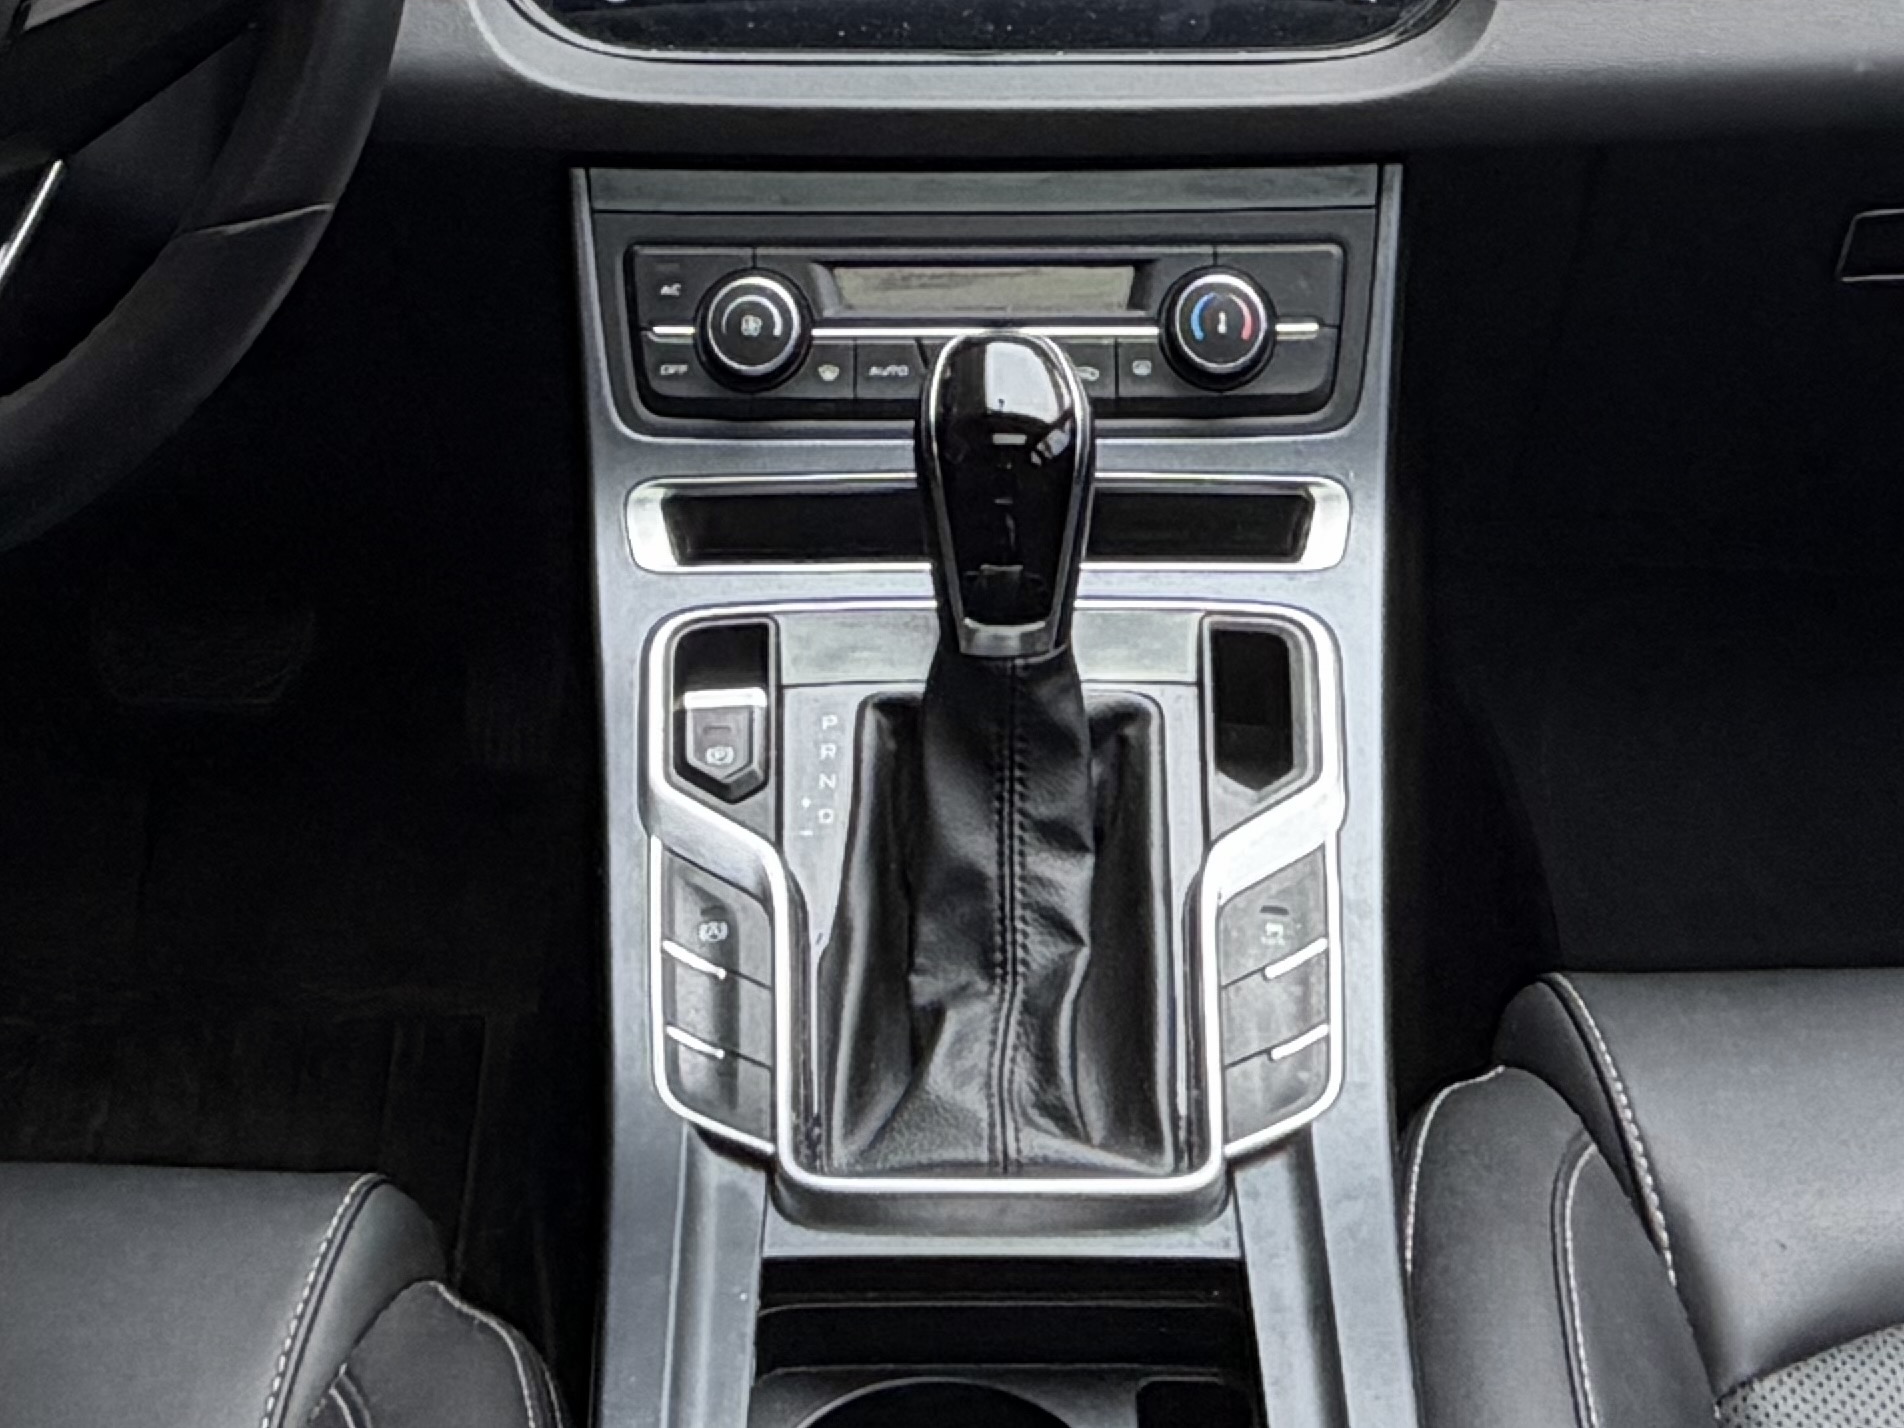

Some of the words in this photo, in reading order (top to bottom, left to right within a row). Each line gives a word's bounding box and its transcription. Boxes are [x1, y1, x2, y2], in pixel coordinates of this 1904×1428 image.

[660, 364, 688, 375] OFF
[868, 365, 910, 377] AUTO
[822, 714, 838, 730] P
[820, 743, 837, 760] R
[819, 773, 836, 789] N
[818, 808, 834, 824] D
